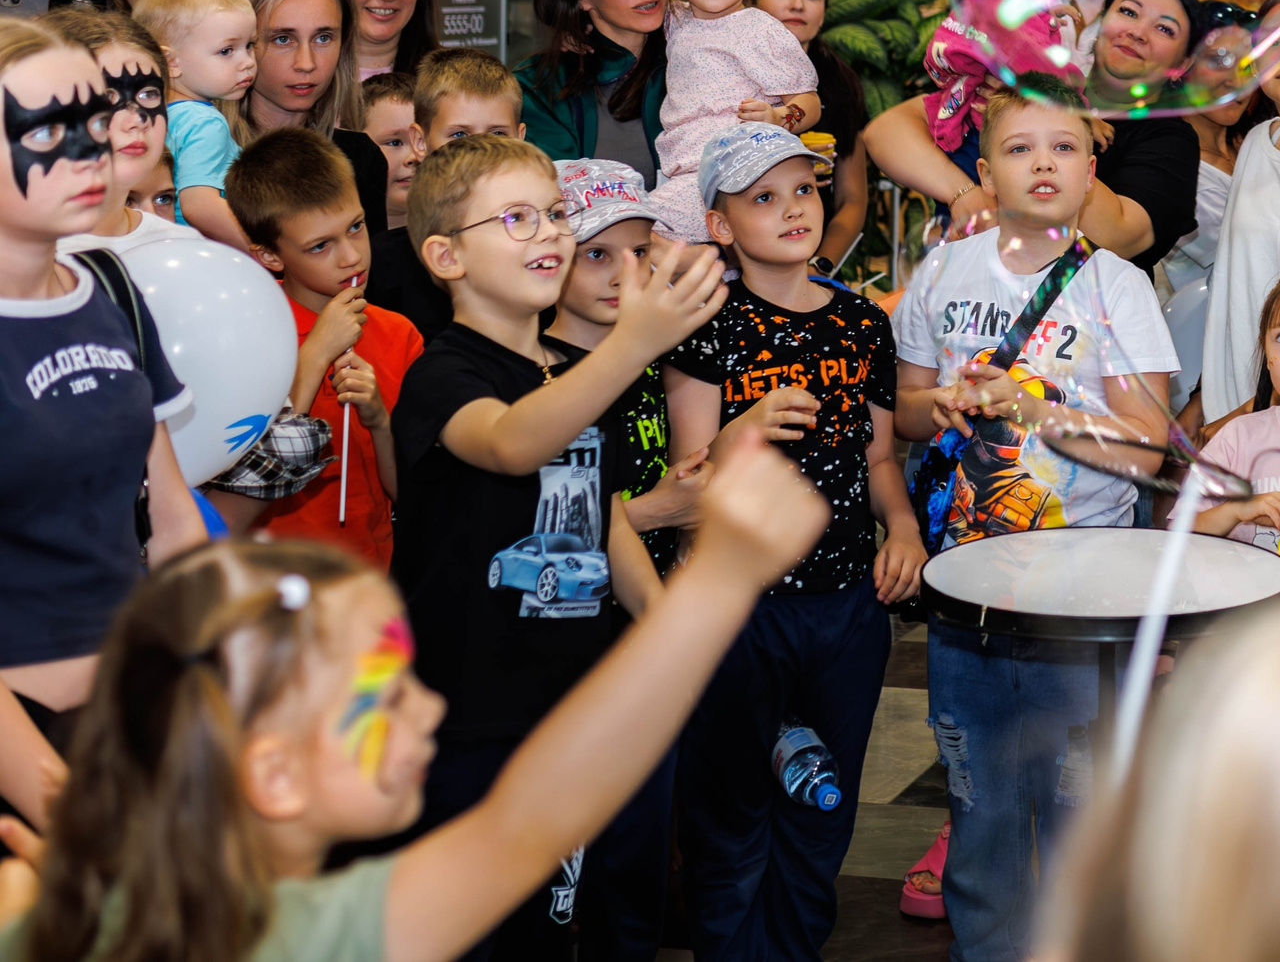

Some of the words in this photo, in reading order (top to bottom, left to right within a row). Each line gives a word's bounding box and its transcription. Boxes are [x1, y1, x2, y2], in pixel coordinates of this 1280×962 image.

[942, 300, 1058, 356] STANDFF
[1055, 325, 1078, 361] 2
[25, 342, 134, 400] COLORADO
